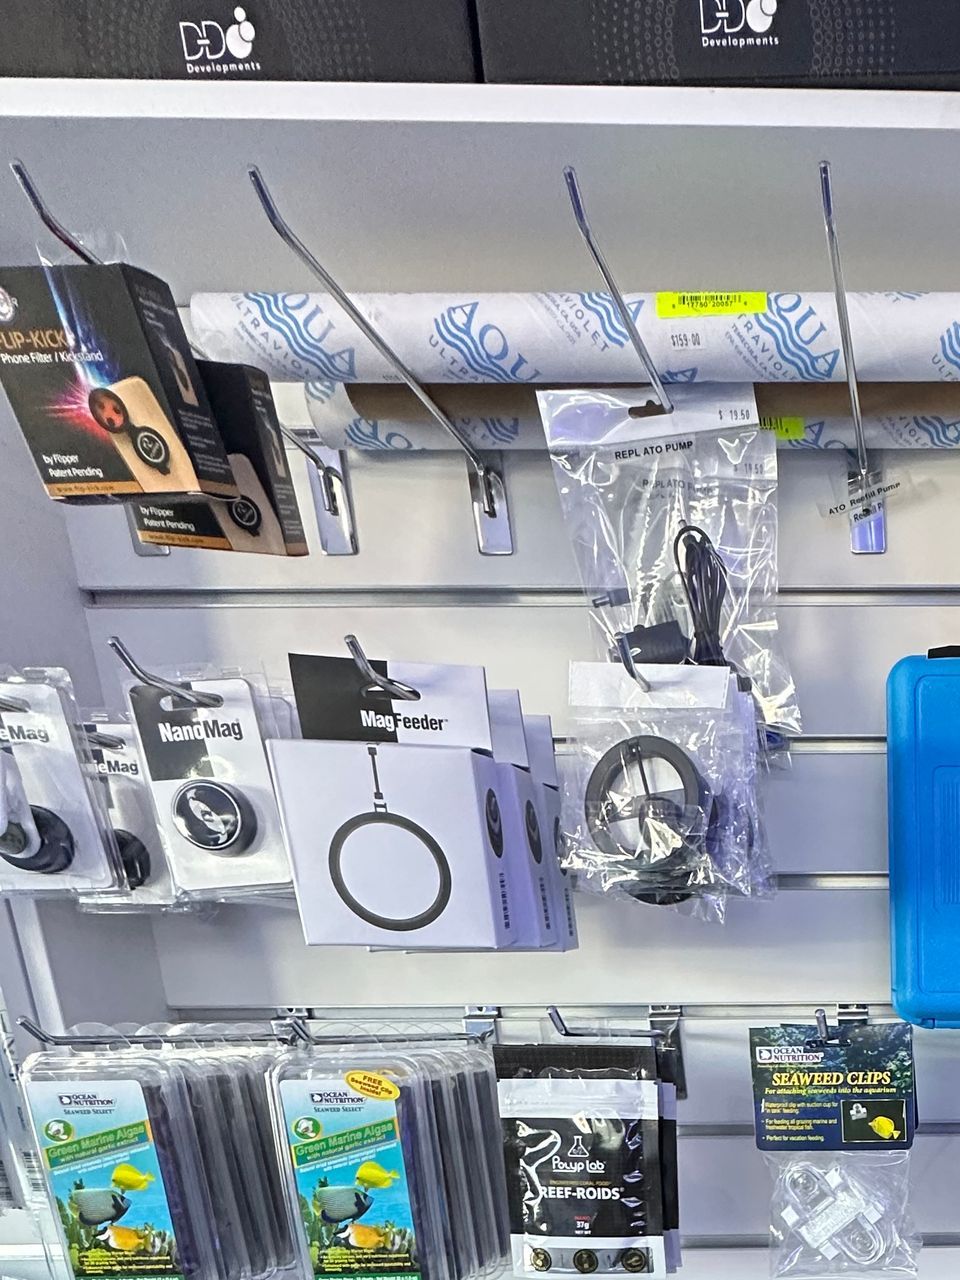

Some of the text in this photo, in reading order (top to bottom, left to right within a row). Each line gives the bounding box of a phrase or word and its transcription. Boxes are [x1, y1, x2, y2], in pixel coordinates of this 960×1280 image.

[702, 35, 779, 47] Developments
[186, 61, 261, 74] Developments
[2, 350, 103, 364] Phone Filter Kickstand
[729, 408, 750, 420] 19.50
[615, 441, 693, 460] REPL ATO PUMP
[43, 454, 79, 464] by Flipper
[49, 467, 103, 478] Patent Pending
[829, 504, 846, 515] ATO
[878, 481, 901, 498] Pump
[361, 710, 444, 732] MagFeeder
[161, 719, 243, 741] NanoMag
[774, 1053, 820, 1061] NUTRITION
[362, 1074, 383, 1086] FREE
[772, 1071, 891, 1086] SEAWEED CLIPS
[295, 1122, 393, 1157] Green Marine Algae
[540, 1186, 620, 1200] REEF-ROIDS
[577, 1220, 589, 1230] 37g
